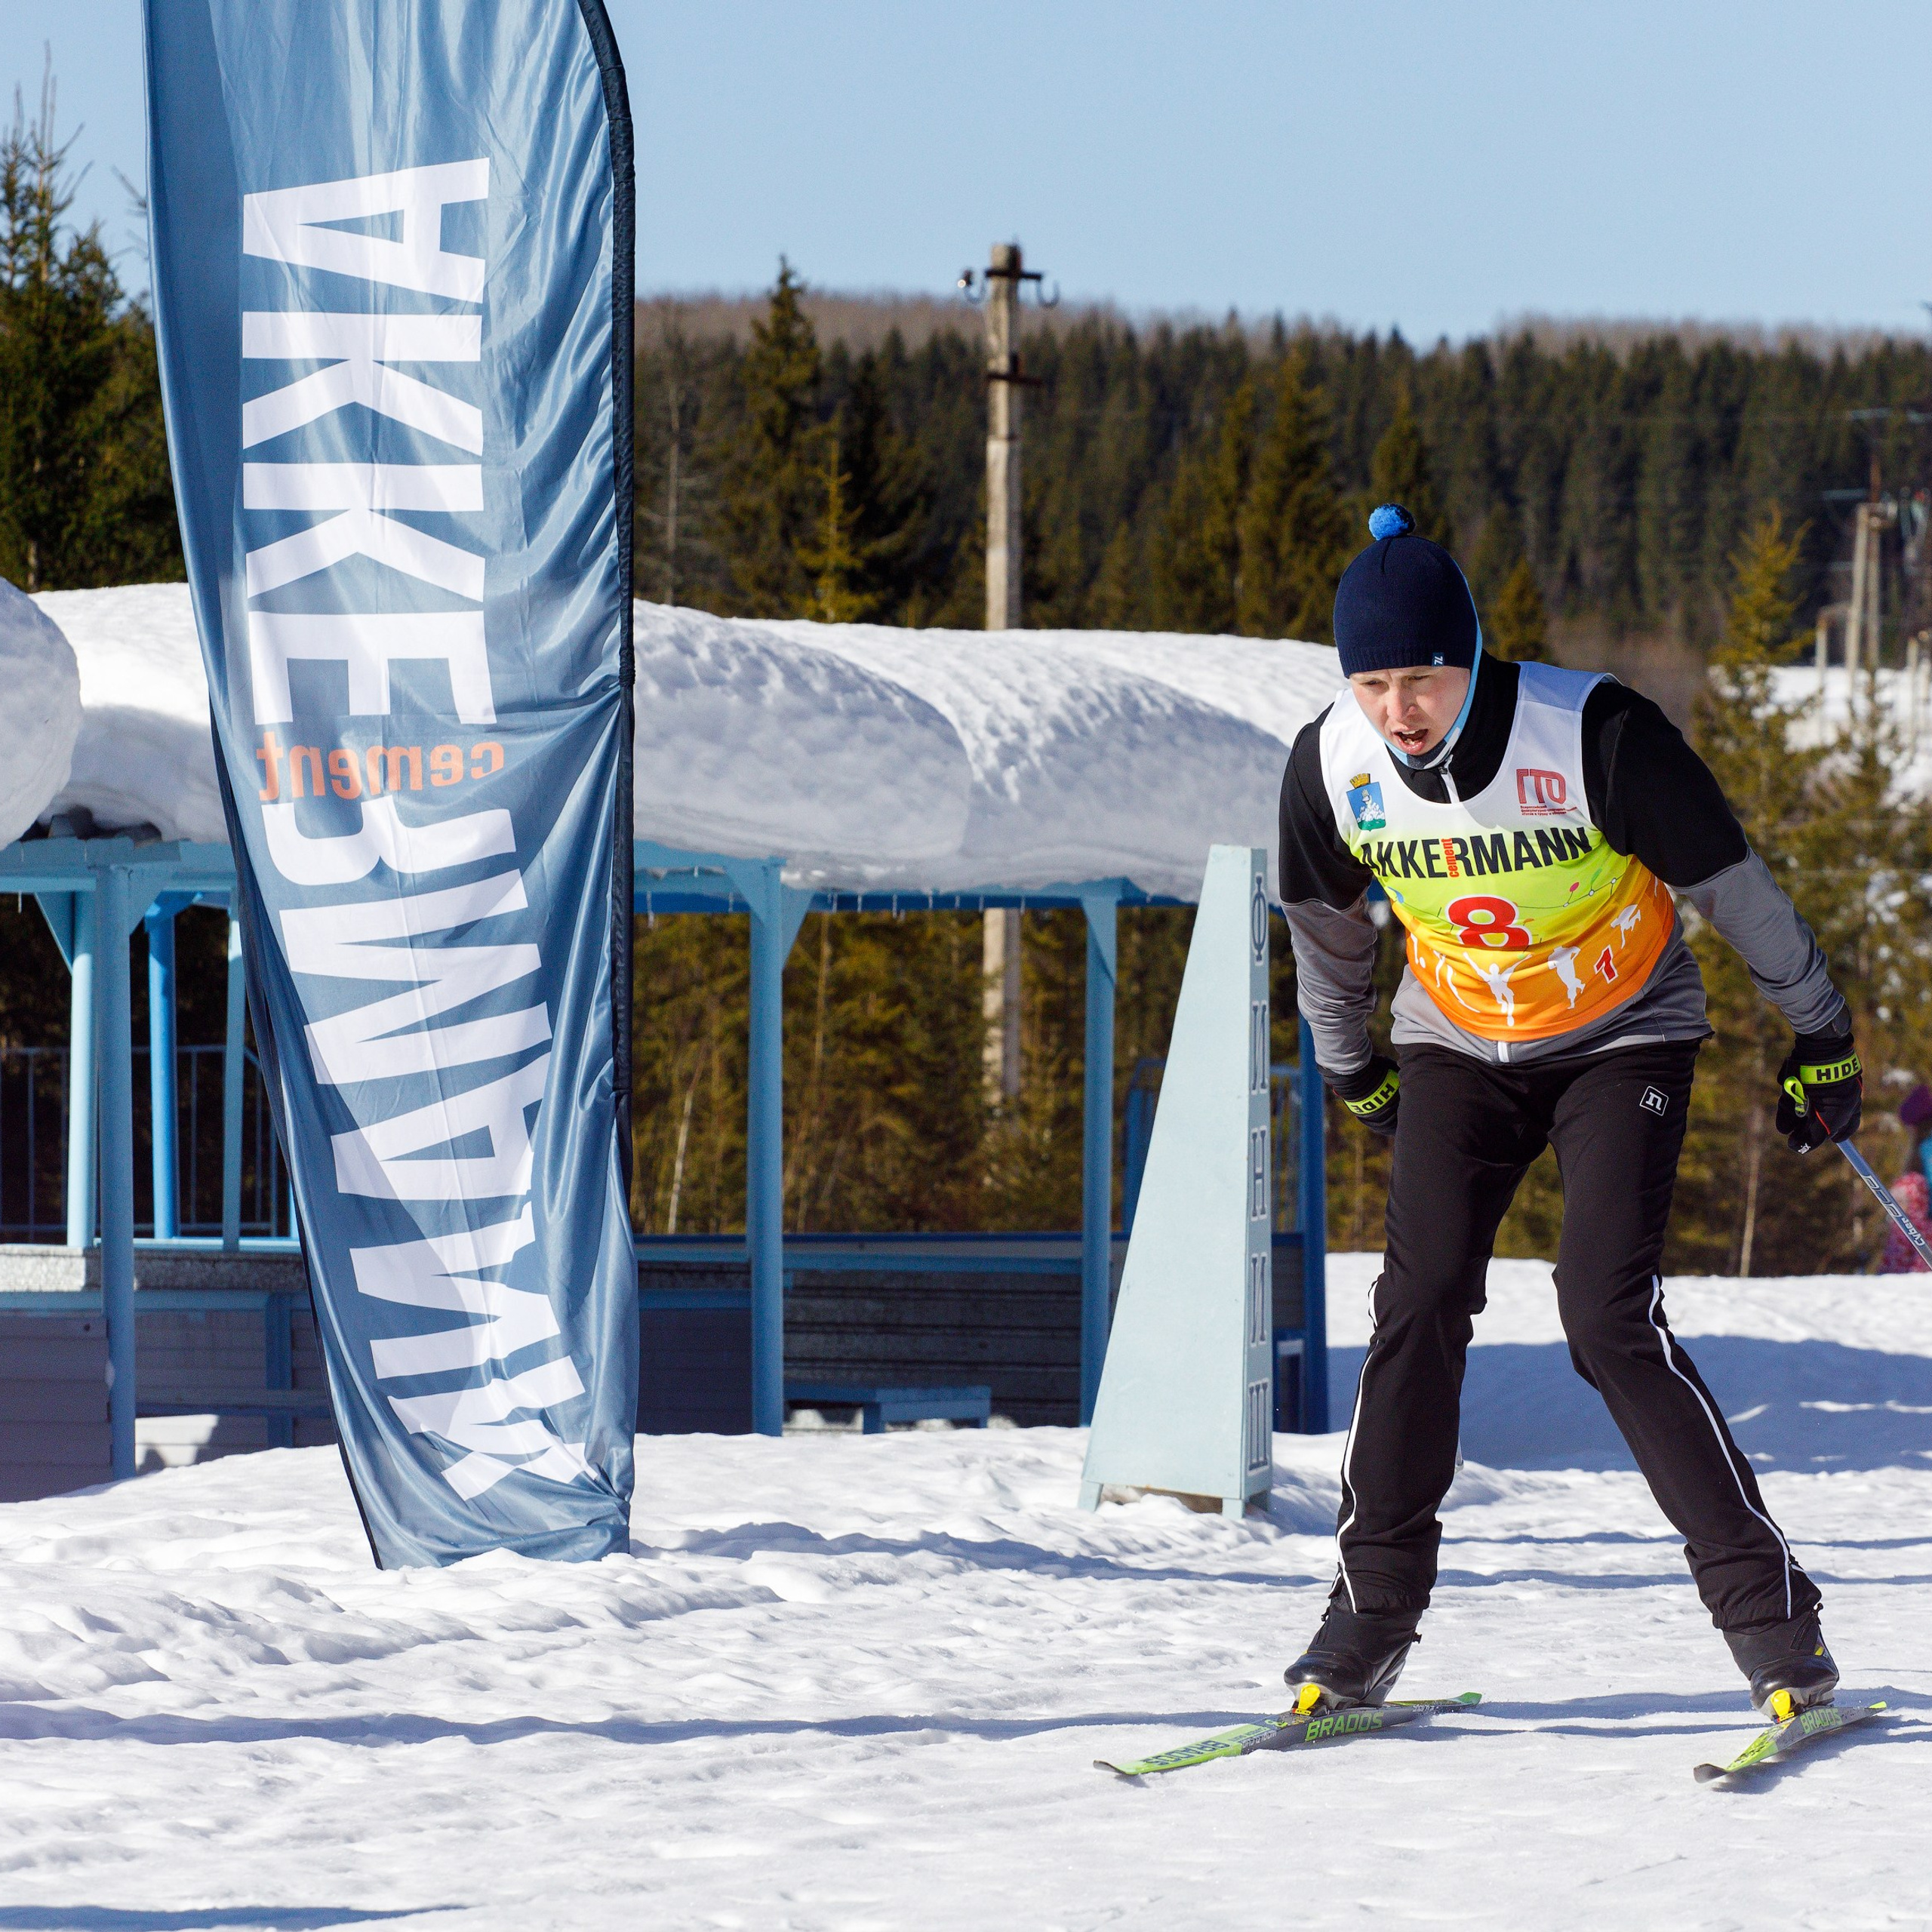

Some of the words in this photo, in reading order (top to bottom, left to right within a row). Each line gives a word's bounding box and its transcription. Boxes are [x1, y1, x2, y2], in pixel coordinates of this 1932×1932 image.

[1360, 827, 1592, 878] AKKERMANN
[1441, 838, 1460, 878] cement
[1446, 895, 1532, 952] 8
[1593, 944, 1618, 983] 1
[1816, 1058, 1859, 1081] HIDE
[1248, 874, 1269, 1472] ФИНИШ
[1305, 1712, 1384, 1742] BRADOS
[1800, 1708, 1843, 1734] BRADOS
[1141, 1740, 1230, 1766] BRADOS
